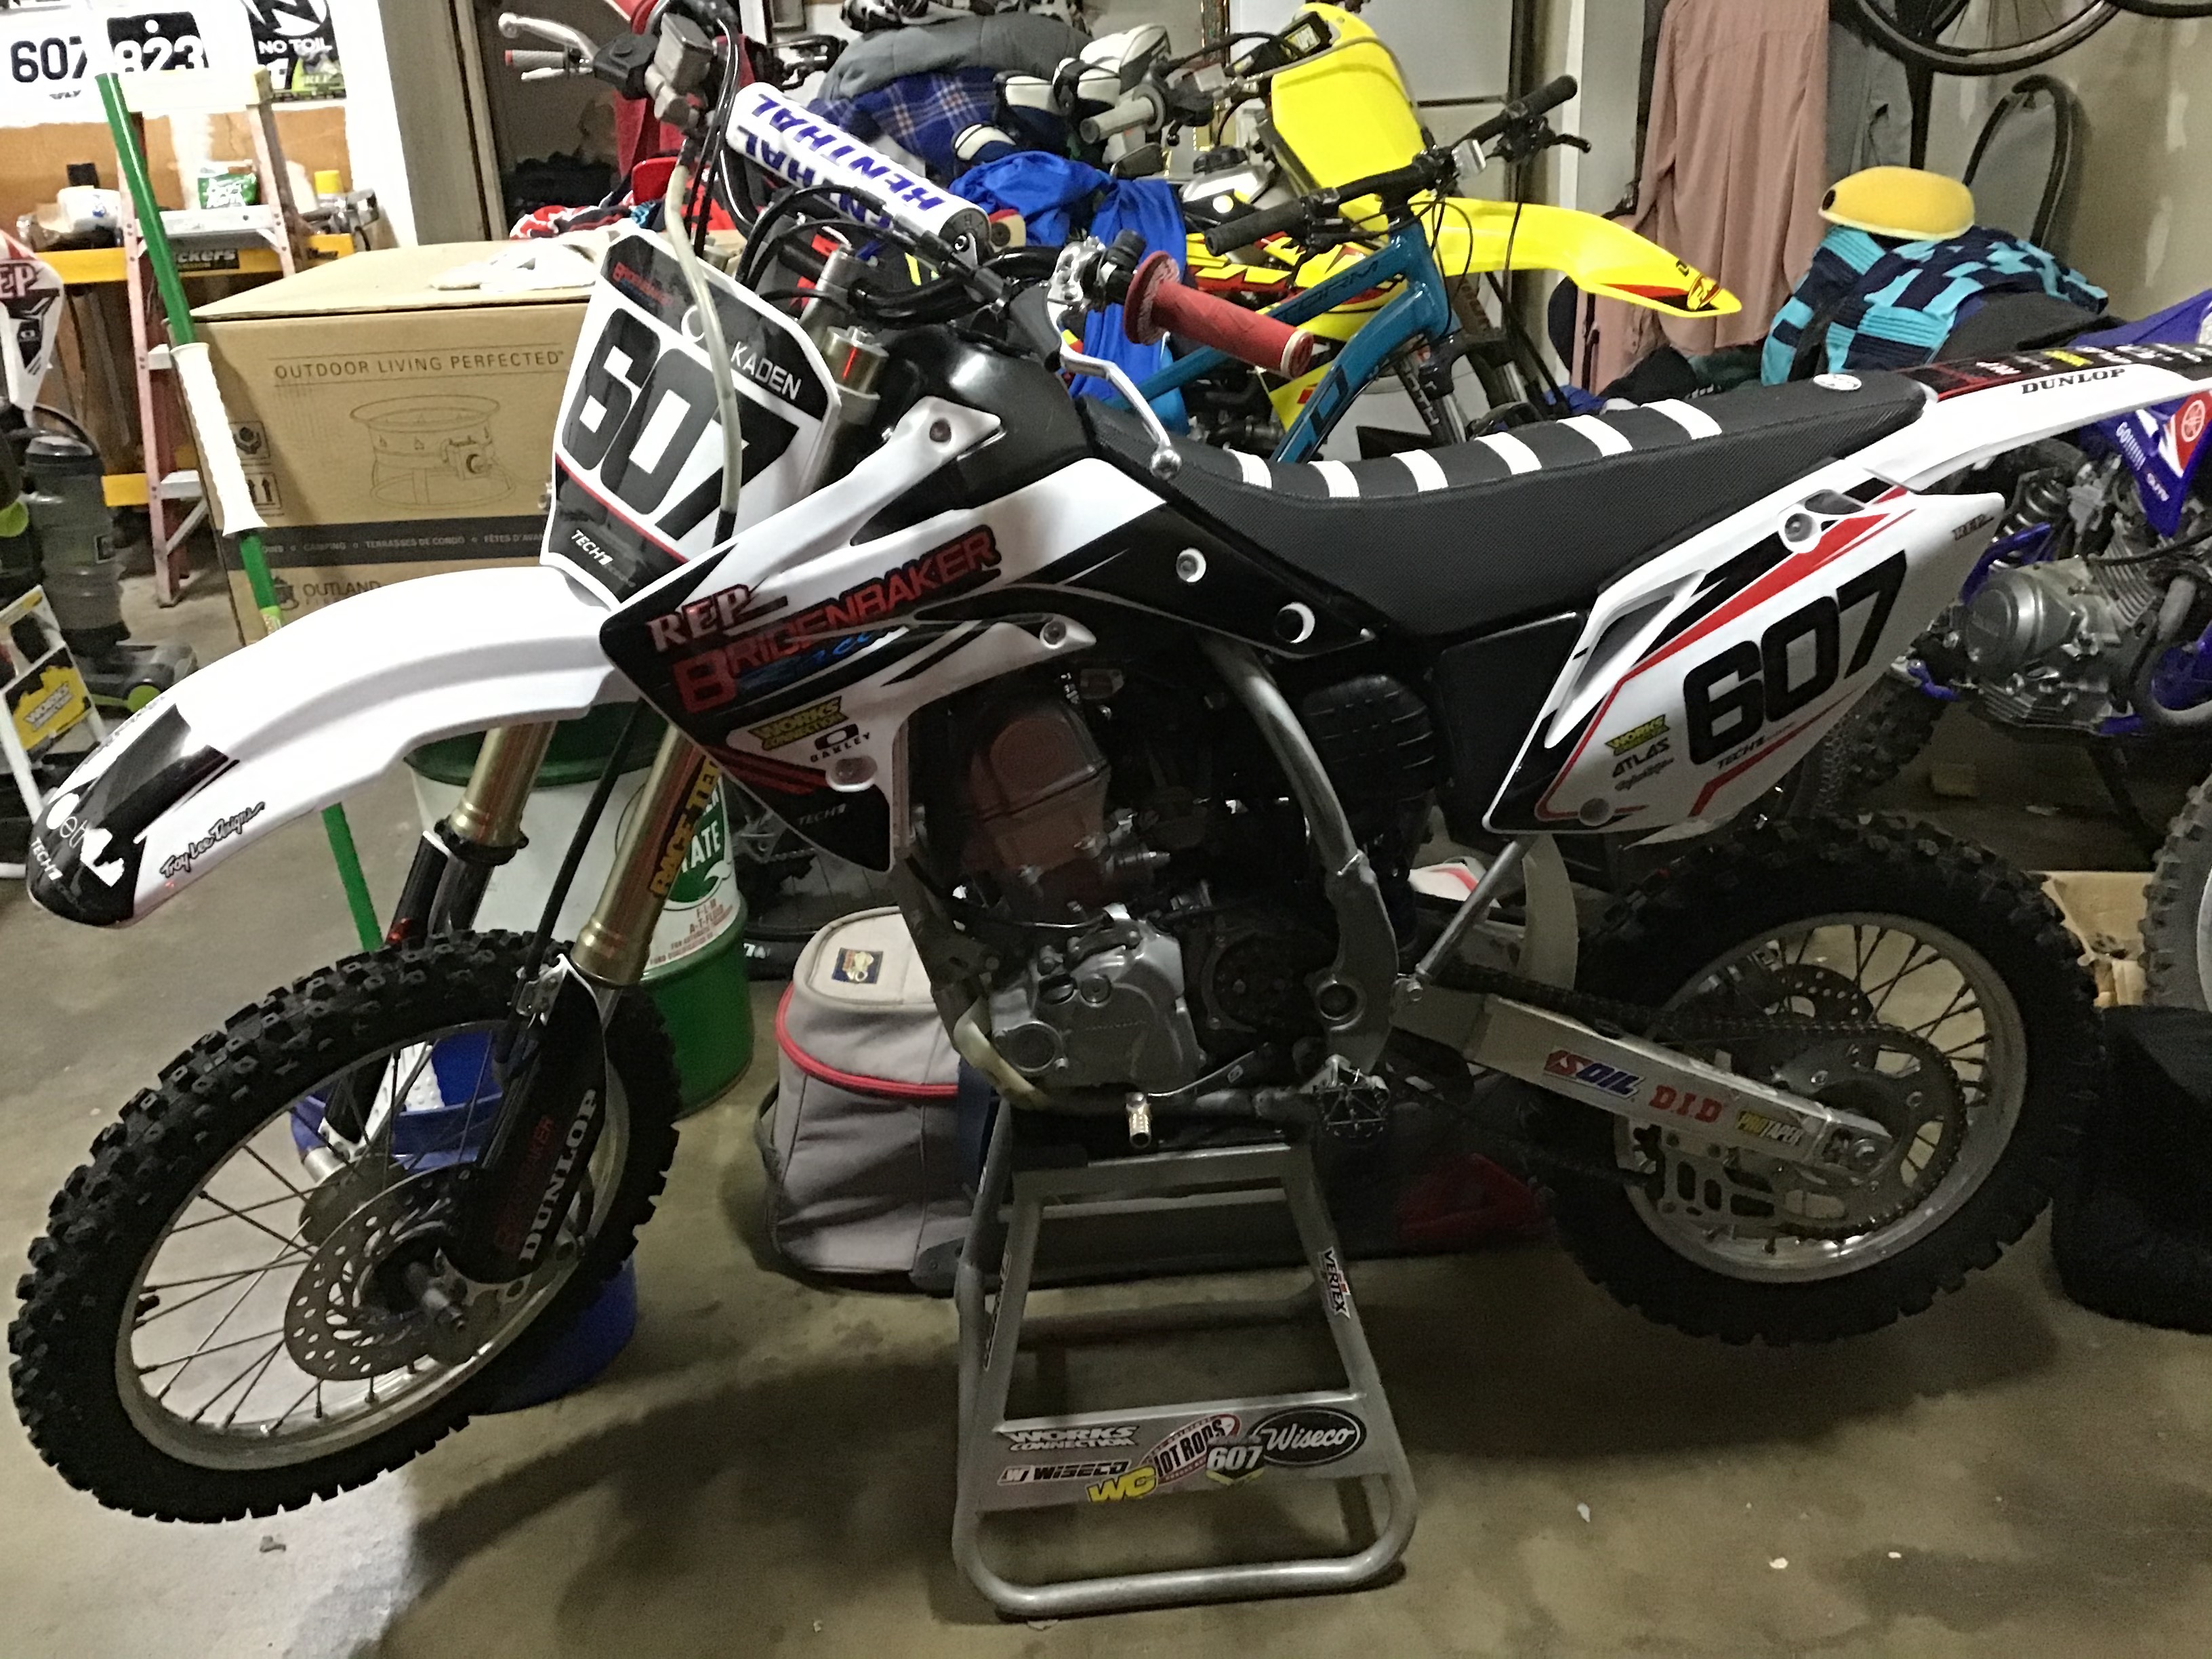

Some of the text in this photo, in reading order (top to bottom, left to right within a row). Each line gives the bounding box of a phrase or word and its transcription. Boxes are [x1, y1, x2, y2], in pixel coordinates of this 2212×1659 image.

[10, 35, 87, 83] 607
[258, 37, 333, 56] NO TOIL
[750, 93, 947, 211] RENTHAL
[274, 361, 369, 380] OUTDOOR
[379, 356, 443, 373] LIVING
[731, 342, 803, 401] KADEN
[2022, 368, 2126, 394] DUNLOP
[562, 308, 800, 541] 607
[302, 580, 381, 598] OUTLAND
[647, 585, 750, 651] REP
[1683, 549, 1908, 766] 607
[749, 696, 842, 739] WORKS
[810, 732, 870, 763] OAKLEY
[1612, 737, 1670, 777] ATLAS
[159, 801, 266, 878] Troy Lee Designs
[518, 1088, 597, 1263] DUNLOP
[1324, 1250, 1347, 1313] VERTEX
[1006, 1426, 1139, 1444] WORKS
[1010, 1436, 1139, 1452] CONNECTION
[1261, 1422, 1355, 1452] Wiseco
[1206, 1446, 1263, 1471] 607
[1086, 1465, 1158, 1503] WC
